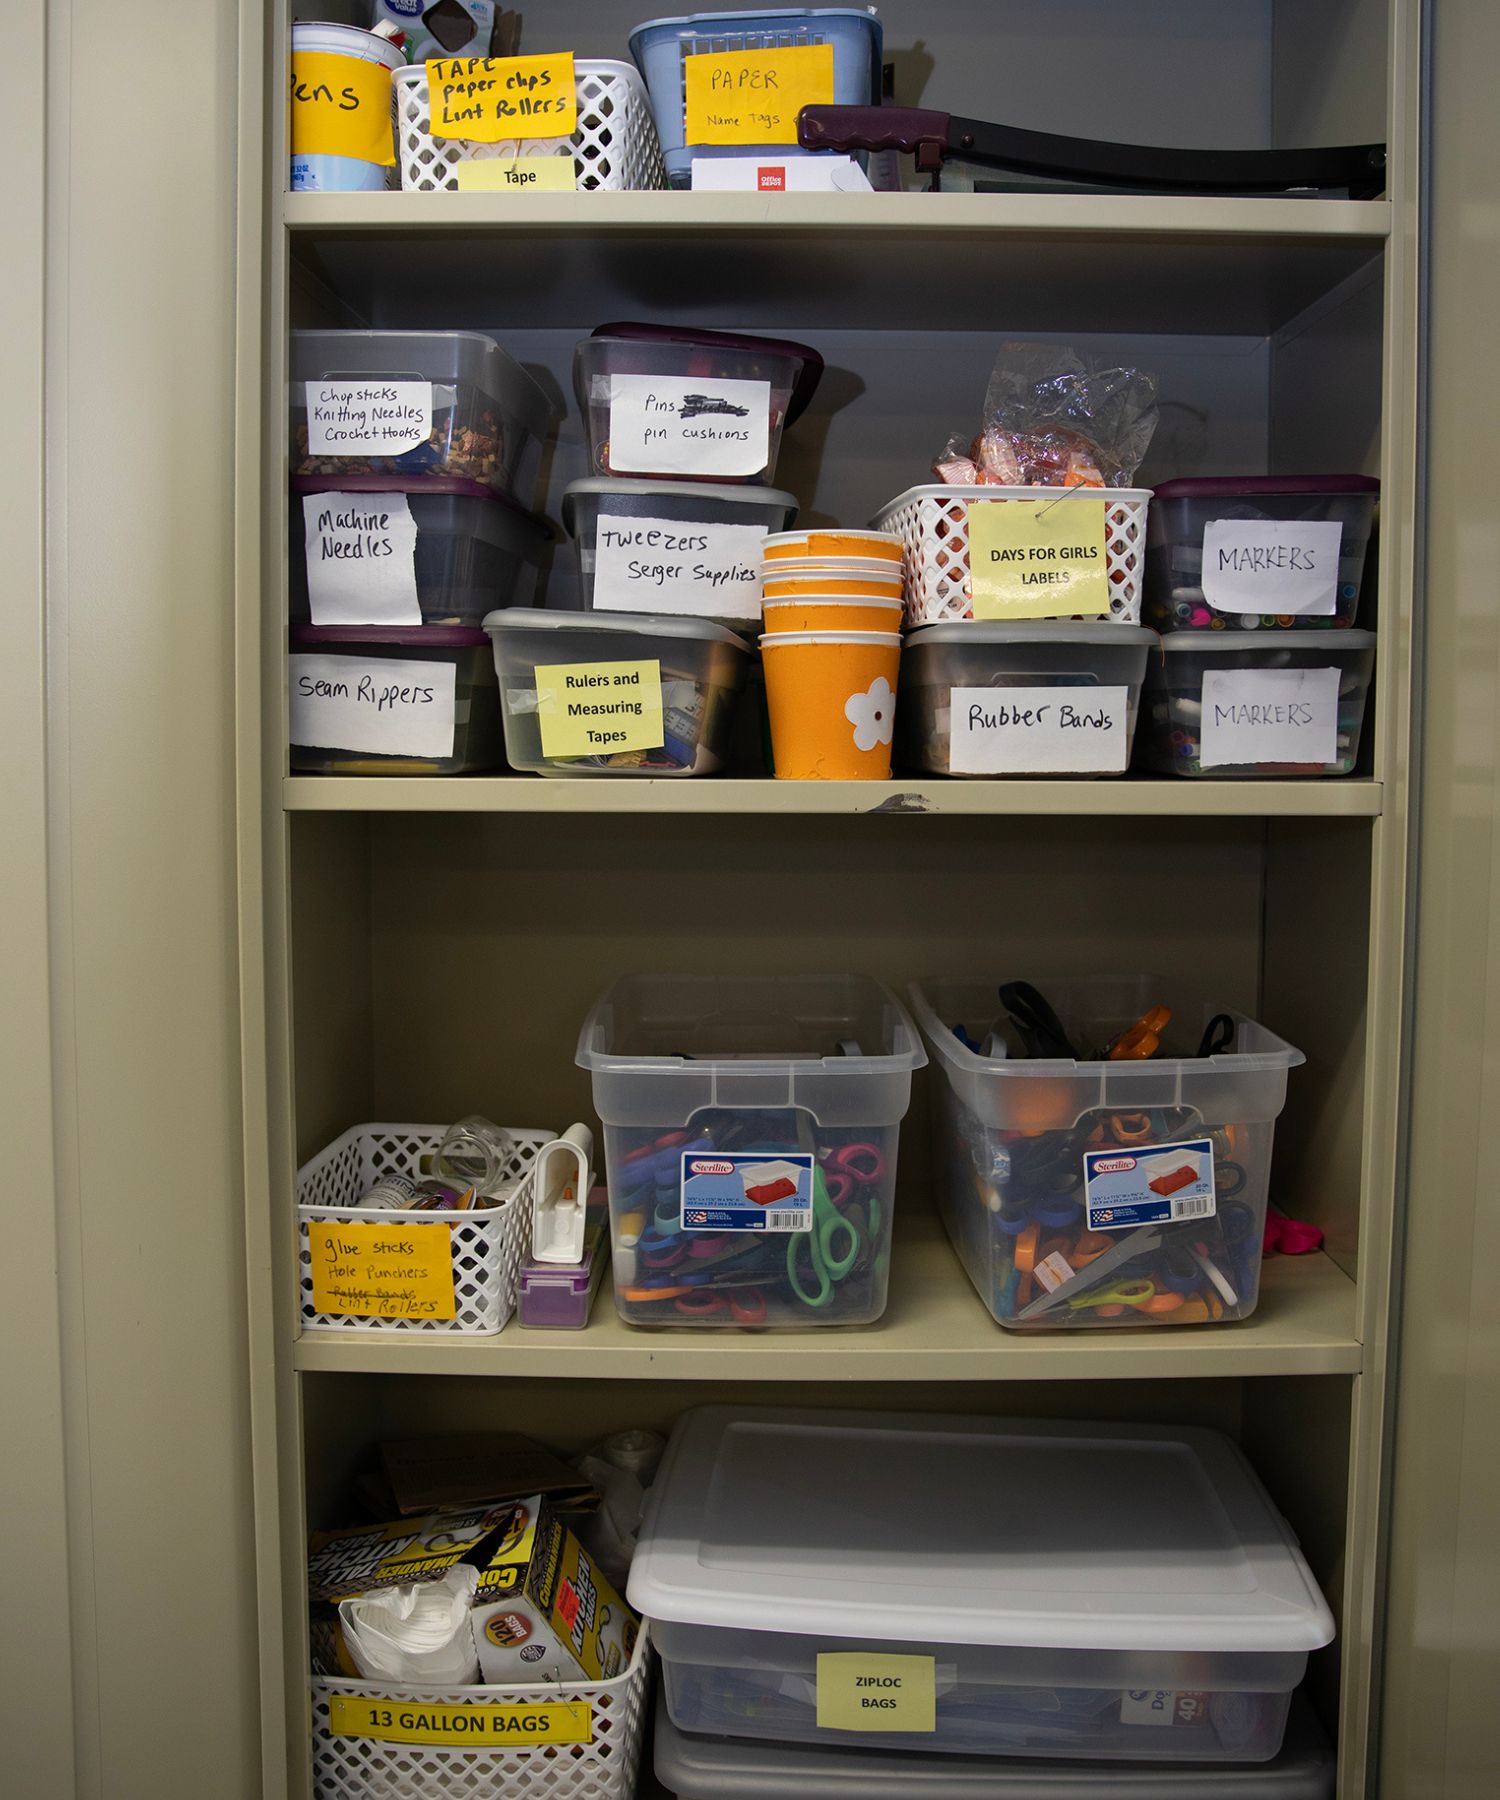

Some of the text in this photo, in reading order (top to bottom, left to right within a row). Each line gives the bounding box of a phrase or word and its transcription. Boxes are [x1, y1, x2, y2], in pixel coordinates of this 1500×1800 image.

[395, 3, 417, 13] Value
[711, 69, 780, 89] PAPER
[443, 78, 497, 103] paper
[442, 96, 567, 124] Lint Rollers
[706, 113, 781, 128] Name Tags
[503, 170, 537, 186] Tape
[644, 394, 675, 412] Pins
[314, 405, 424, 428] Knitting Needles
[325, 427, 421, 441] Crochet Hooks
[644, 427, 749, 445] pin cushions
[318, 509, 389, 531] Machine
[321, 535, 393, 560] Needles
[602, 530, 708, 552] Tweezers
[990, 546, 1098, 562] DAYS FOR GIRLS
[1218, 545, 1315, 571] MARKERS
[628, 561, 757, 586] Serger Supplies
[1021, 571, 1071, 586] LABELS
[565, 671, 640, 689] Rulers and
[298, 675, 434, 711] Seam Rippers
[567, 700, 643, 717] Measuring
[968, 704, 1113, 731] Rubber Bands
[1214, 703, 1313, 728] MARKERS
[587, 730, 627, 745] Tapes
[695, 1163, 730, 1173] Sterilite
[1097, 1159, 1132, 1172] Sterilite
[324, 1239, 415, 1263] glue sticks
[328, 1265, 428, 1280] Hole Punchers
[378, 1300, 439, 1315] Rollers
[309, 1534, 421, 1572] KITCHE
[321, 1560, 380, 1586] TALL
[586, 1585, 598, 1632] BAGS
[489, 1620, 516, 1646] 120
[504, 1615, 527, 1638] BAGS
[855, 1677, 902, 1689] ZIPLOC
[861, 1698, 897, 1709] BAGS
[368, 1710, 550, 1733] 13 GALLON BAGS
